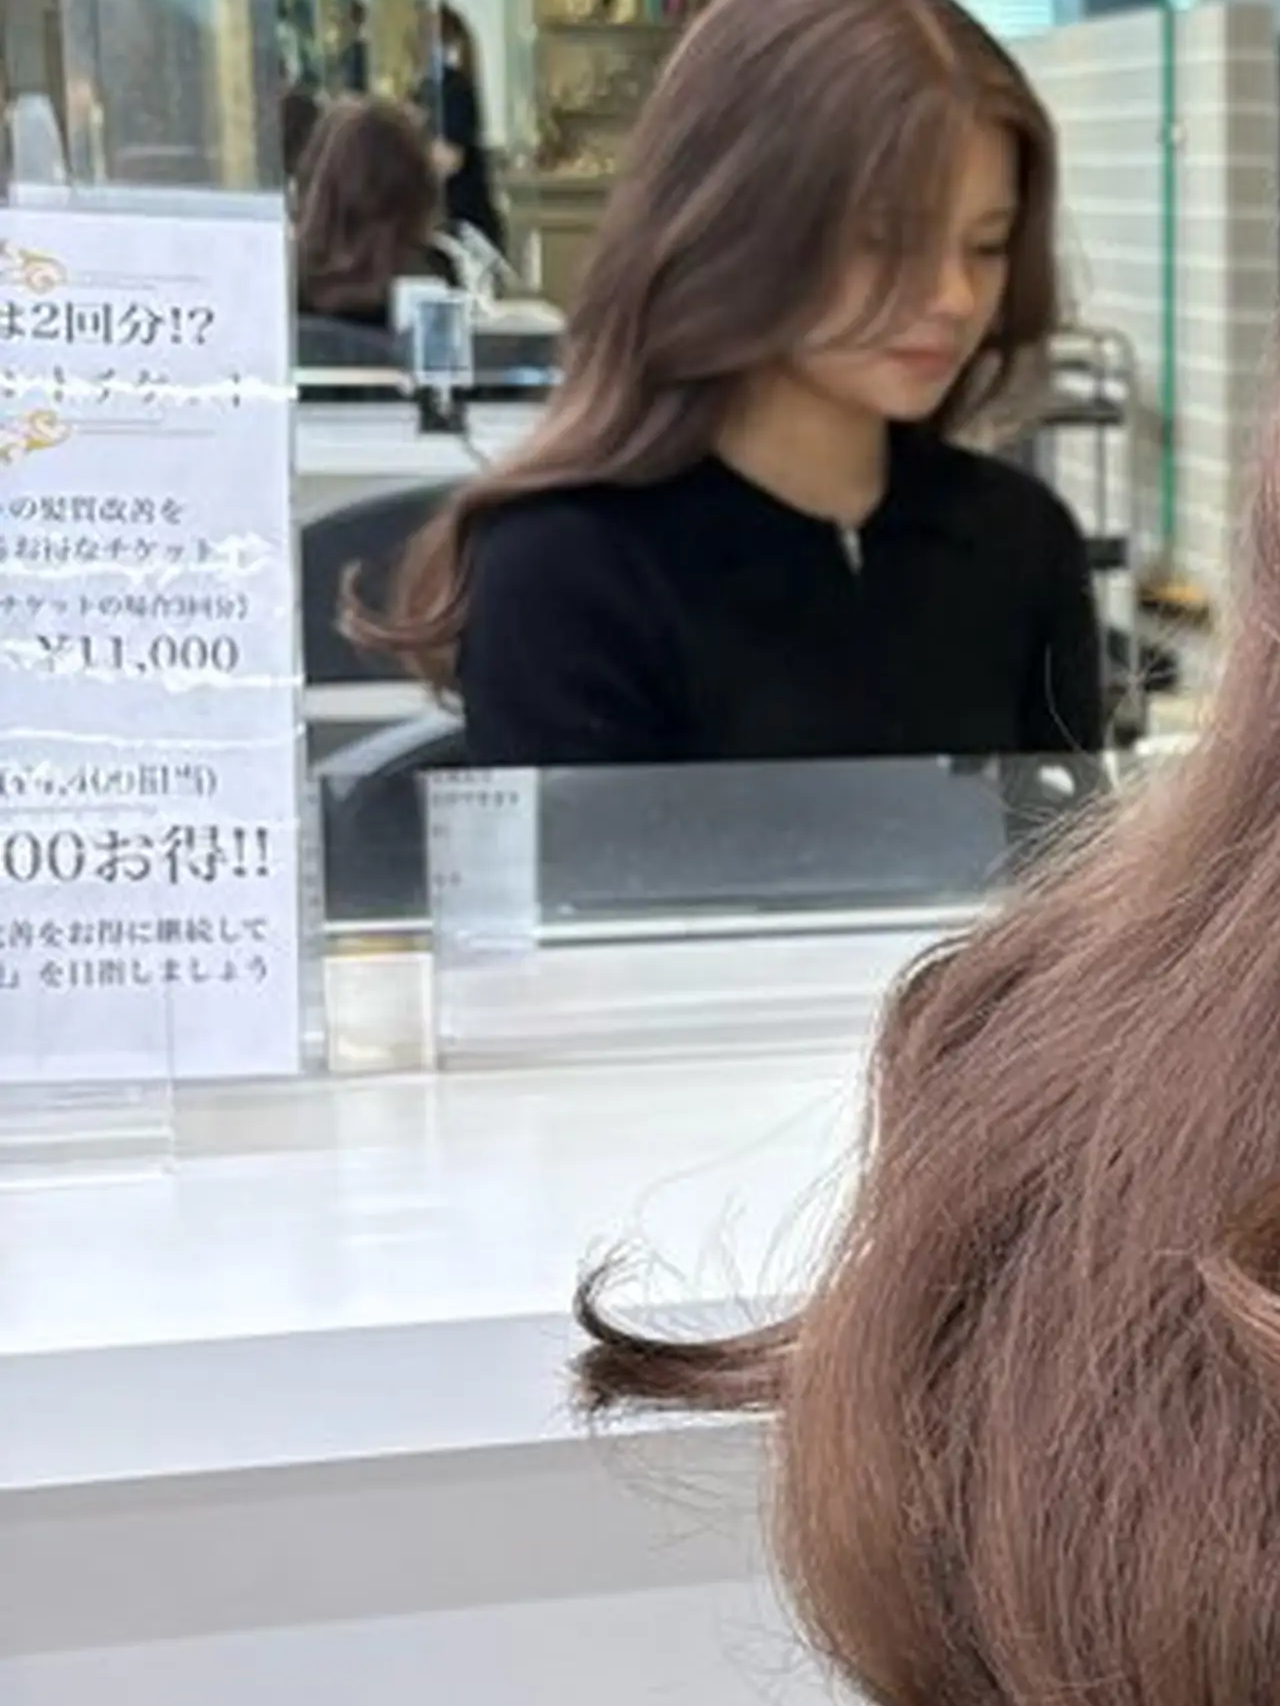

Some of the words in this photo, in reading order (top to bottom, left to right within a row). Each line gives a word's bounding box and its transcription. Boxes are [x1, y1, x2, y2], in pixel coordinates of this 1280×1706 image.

[0, 916, 268, 949] 善をお得に継続して
